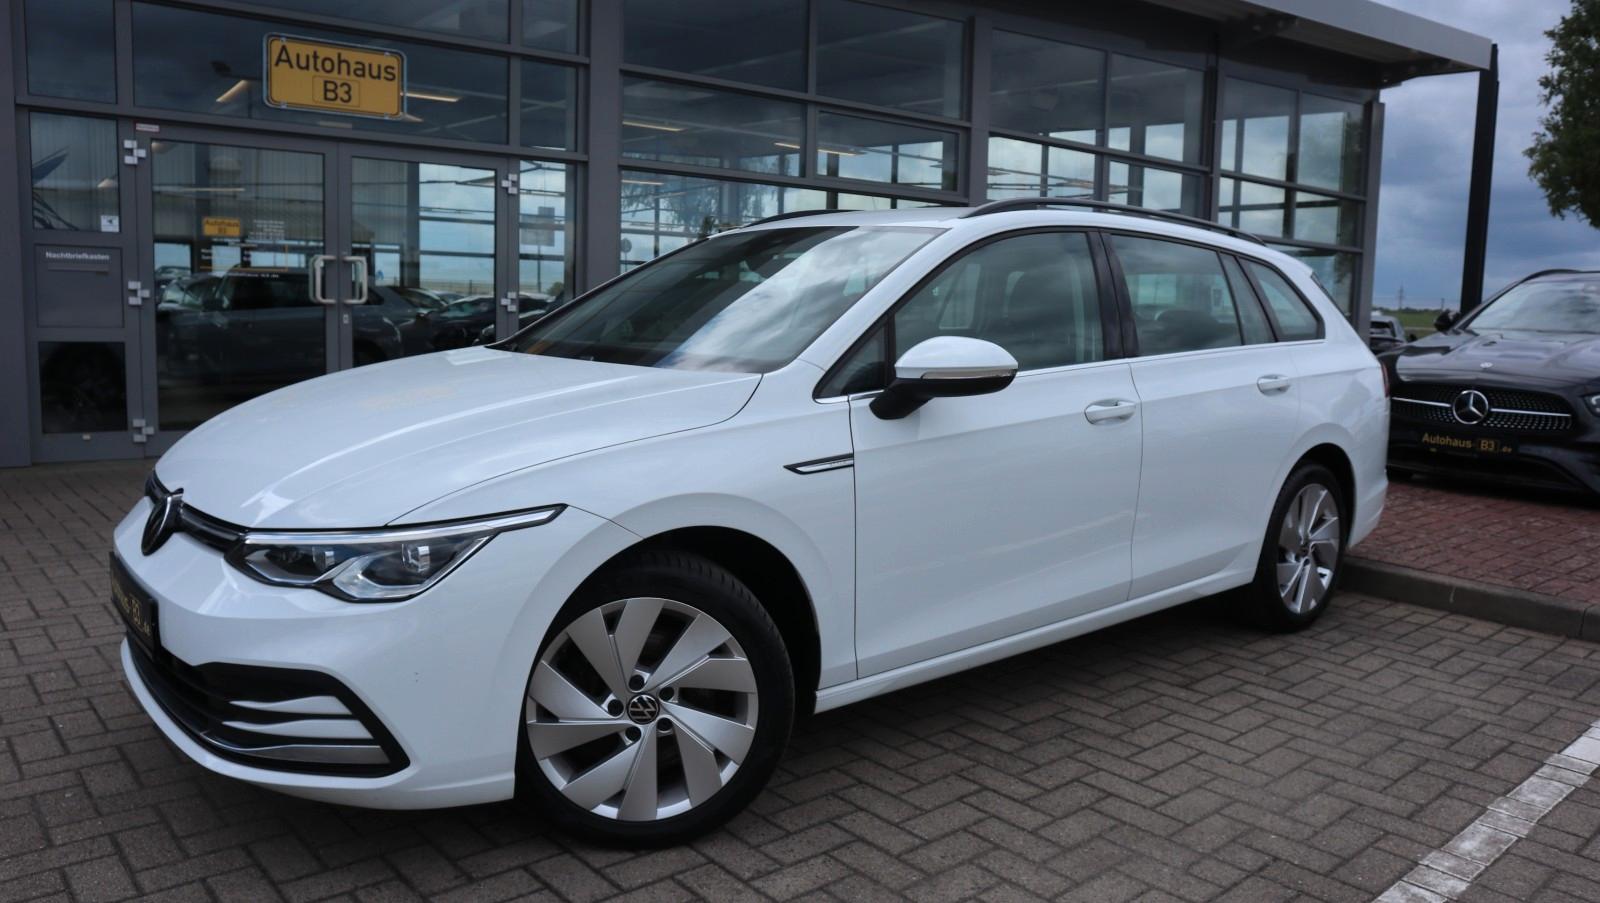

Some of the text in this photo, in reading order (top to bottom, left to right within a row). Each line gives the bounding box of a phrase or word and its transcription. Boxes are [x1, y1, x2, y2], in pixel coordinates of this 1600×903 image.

[274, 44, 397, 81] Autohaus
[323, 80, 353, 104] B3
[1422, 432, 1472, 448] Autohaus
